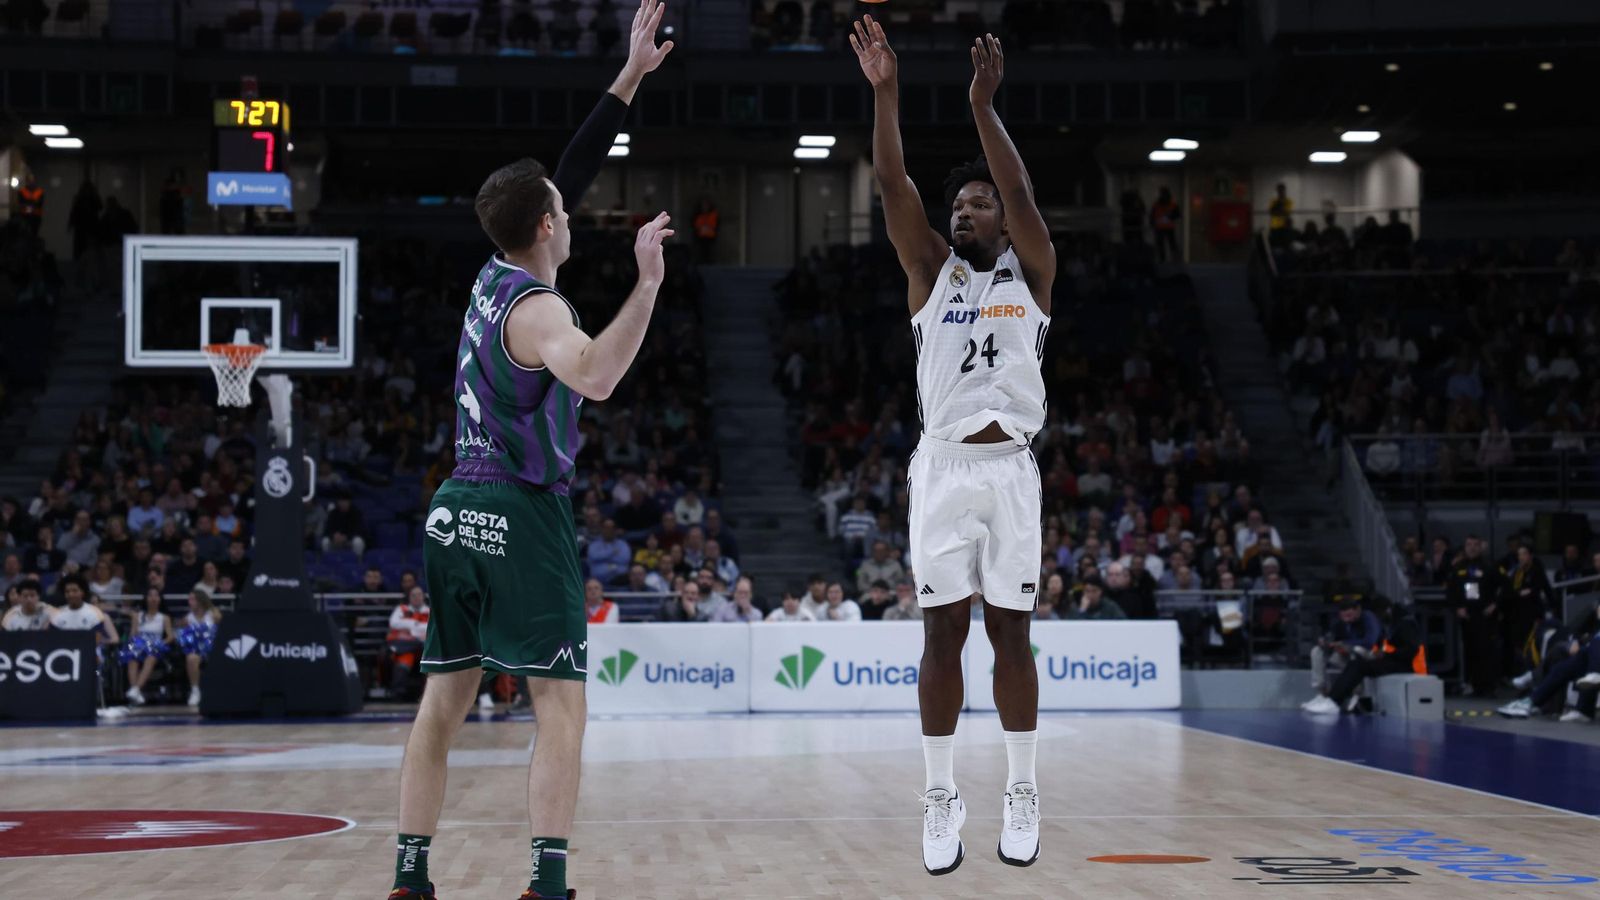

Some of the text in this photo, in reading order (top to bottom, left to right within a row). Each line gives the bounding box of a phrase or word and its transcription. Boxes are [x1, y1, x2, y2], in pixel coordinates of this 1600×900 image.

[252, 132, 275, 171] 7
[941, 304, 1026, 324] AUTHERO
[960, 333, 1000, 374] 24
[458, 509, 509, 531] COSTA
[458, 524, 507, 544] DEL SOL
[460, 537, 506, 557] MÁLAGA
[260, 642, 328, 662] Unicaja
[644, 662, 735, 689] Unicaja
[833, 660, 918, 686] Unica
[1047, 655, 1157, 688] Unicaja
[401, 845, 419, 872] UNICAJ
